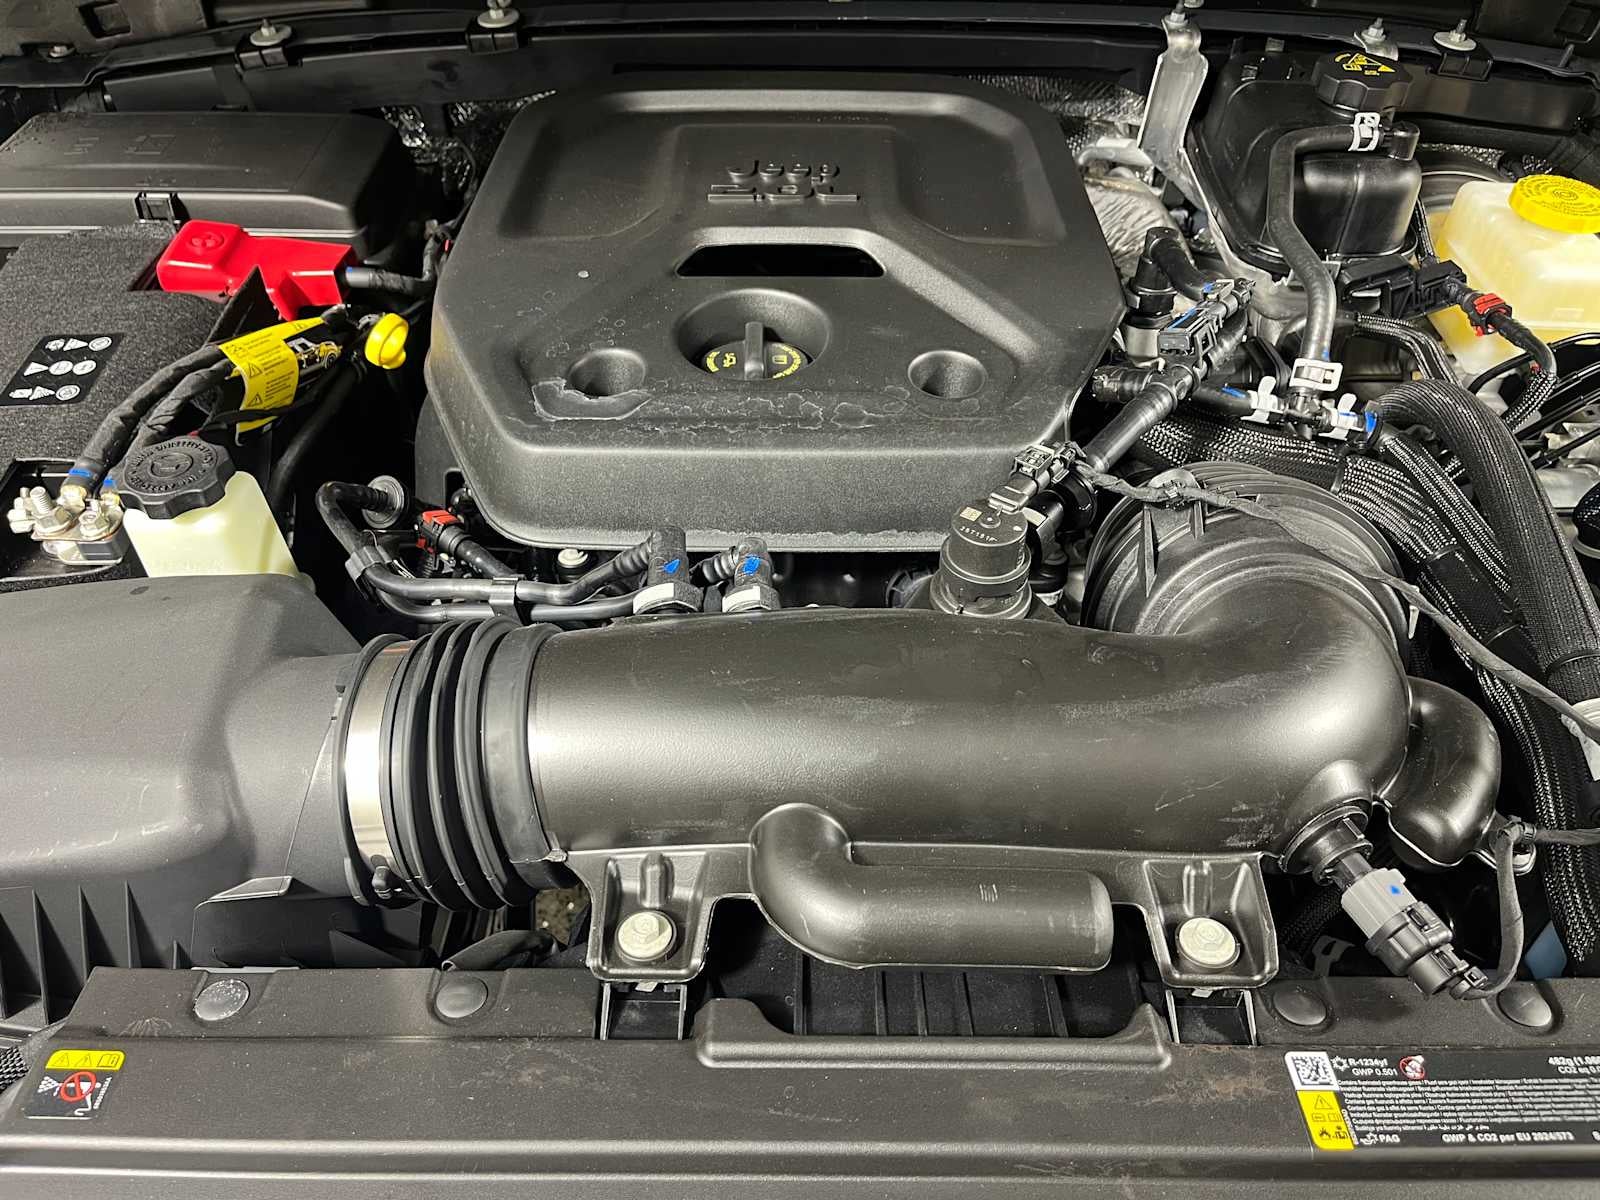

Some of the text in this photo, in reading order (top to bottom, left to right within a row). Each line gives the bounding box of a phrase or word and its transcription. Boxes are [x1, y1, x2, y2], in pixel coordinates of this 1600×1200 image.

[727, 160, 840, 185] Jeep
[1351, 1067, 1398, 1076] GWP 0.501
[1558, 1066, 1578, 1075] CO2
[1378, 1134, 1401, 1143] PAG
[1442, 1133, 1466, 1143] GWP
[1466, 1133, 1477, 1143] &
[1477, 1132, 1499, 1143] CO2
[1515, 1131, 1532, 1142] EU
